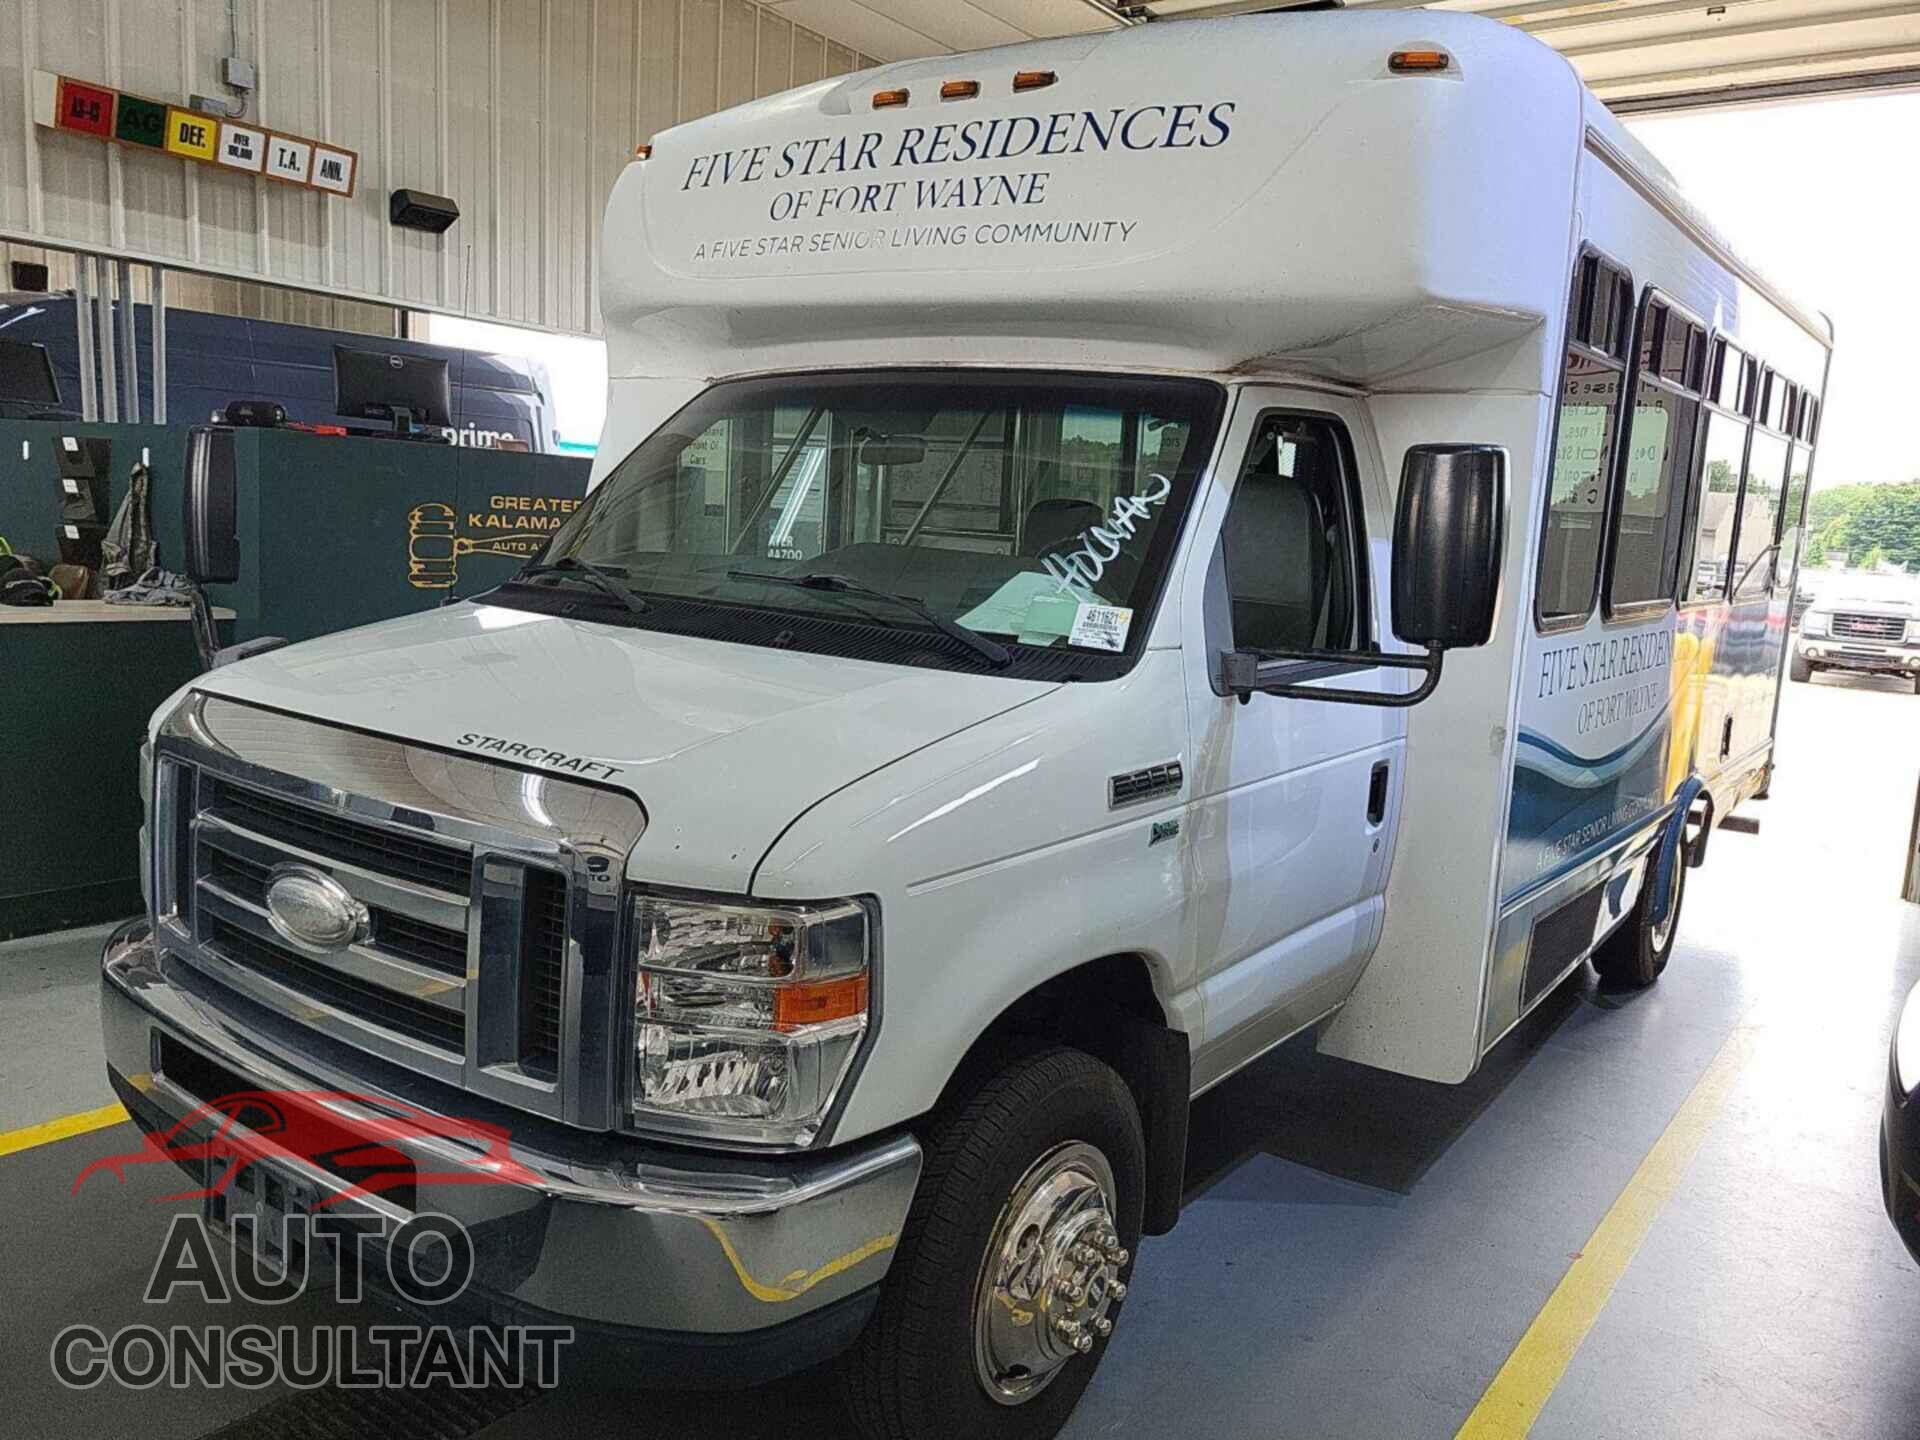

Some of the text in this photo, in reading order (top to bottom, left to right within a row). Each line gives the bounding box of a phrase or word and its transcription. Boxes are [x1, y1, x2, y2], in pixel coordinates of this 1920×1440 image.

[278, 147, 300, 172] T.A.
[681, 102, 1236, 192] FIVE STAR RESIDENCES
[770, 172, 1050, 221] OF FORT WAYNE
[694, 221, 1138, 260] A FIVE STAR SENIOR LIVING COMMUNITY
[492, 541, 527, 553] AUTO
[1538, 646, 1579, 698] FIVE
[1580, 639, 1618, 687] STAR
[1578, 700, 1595, 734] OF
[1594, 692, 1623, 729] FORT
[456, 733, 624, 780] STARCRAFT
